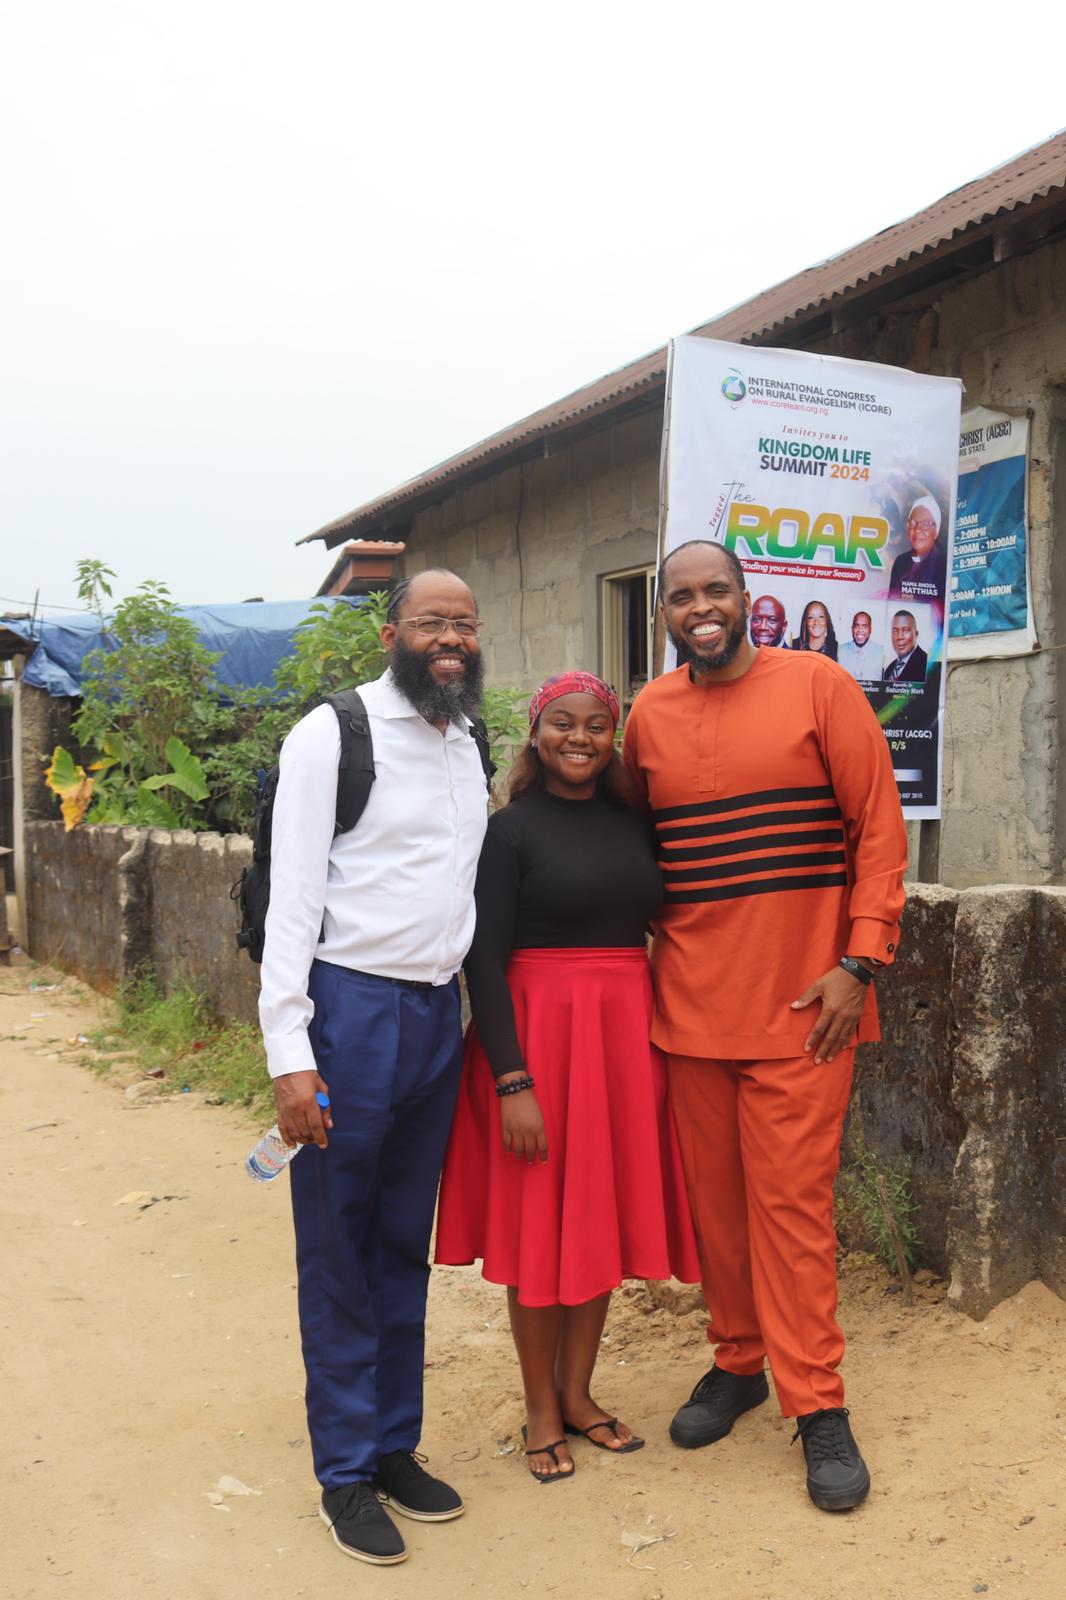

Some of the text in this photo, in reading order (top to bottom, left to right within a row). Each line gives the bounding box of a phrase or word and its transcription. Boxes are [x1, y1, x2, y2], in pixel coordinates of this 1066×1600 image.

[749, 376, 876, 403] INTERNATIONAL CONGRESS
[748, 386, 892, 416] ON RURAL EVANGELISM (ICORE)
[782, 425, 849, 442] Invites you to
[758, 437, 872, 466] KINGDOM LIFE
[968, 443, 986, 455] STATE
[760, 455, 870, 482] SUMMIT 2024
[715, 480, 756, 538] The
[957, 514, 979, 527] :30AM
[724, 502, 890, 568] ROAR
[986, 535, 1017, 549] 10:00AM
[769, 565, 787, 576] your
[787, 565, 806, 575] voice
[807, 567, 815, 576] in
[815, 569, 833, 579] your
[833, 569, 862, 581] Season)
[901, 586, 938, 596] MATTHIAS
[882, 729, 932, 739] HRIST (ACGC)
[891, 741, 906, 751] R/S
